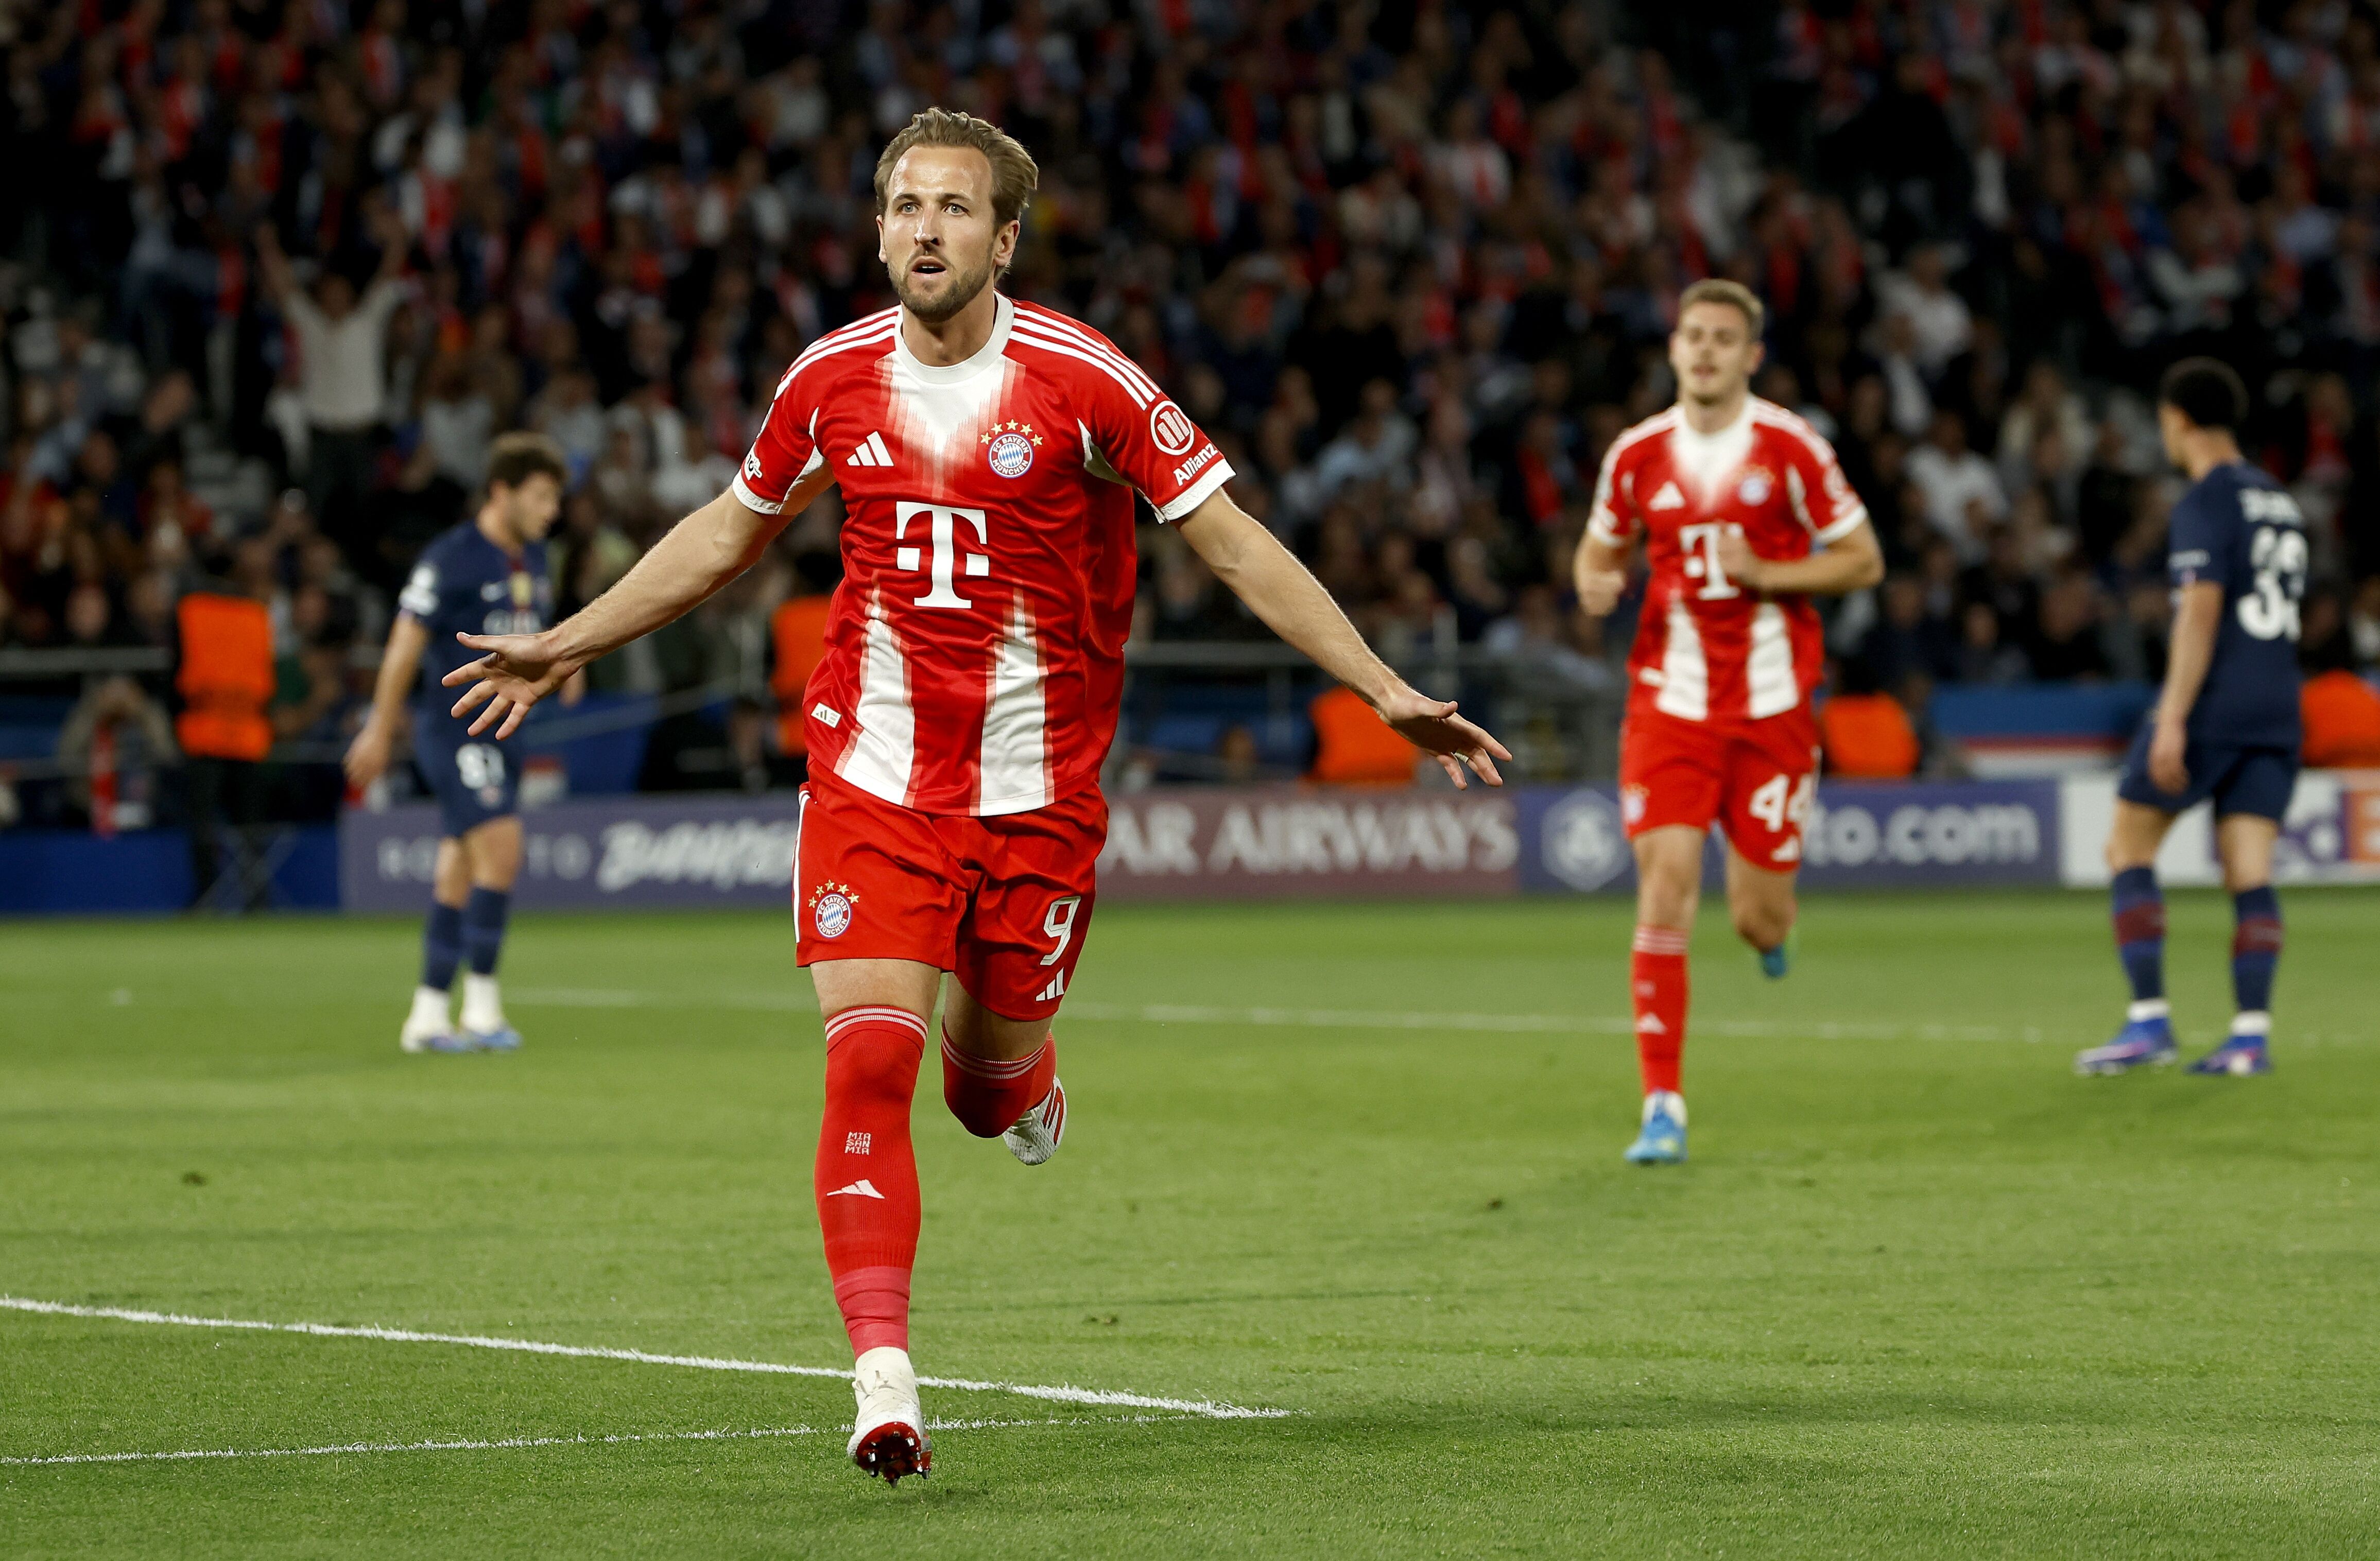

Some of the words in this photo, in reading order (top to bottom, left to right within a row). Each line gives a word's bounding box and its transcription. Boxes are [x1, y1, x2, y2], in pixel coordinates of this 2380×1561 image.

[992, 442, 1002, 453] FC
[1002, 437, 1029, 454] BAYERN
[1173, 443, 1218, 487] Allianz
[896, 501, 990, 609] T
[1208, 799, 1520, 874] AIRWAYS
[818, 905, 825, 915] FC
[824, 897, 848, 912] BAYERN
[1040, 896, 1081, 966] 9
[846, 1139, 870, 1148] SAN
[848, 1132, 871, 1140] MIA
[844, 1146, 869, 1155] MIA
